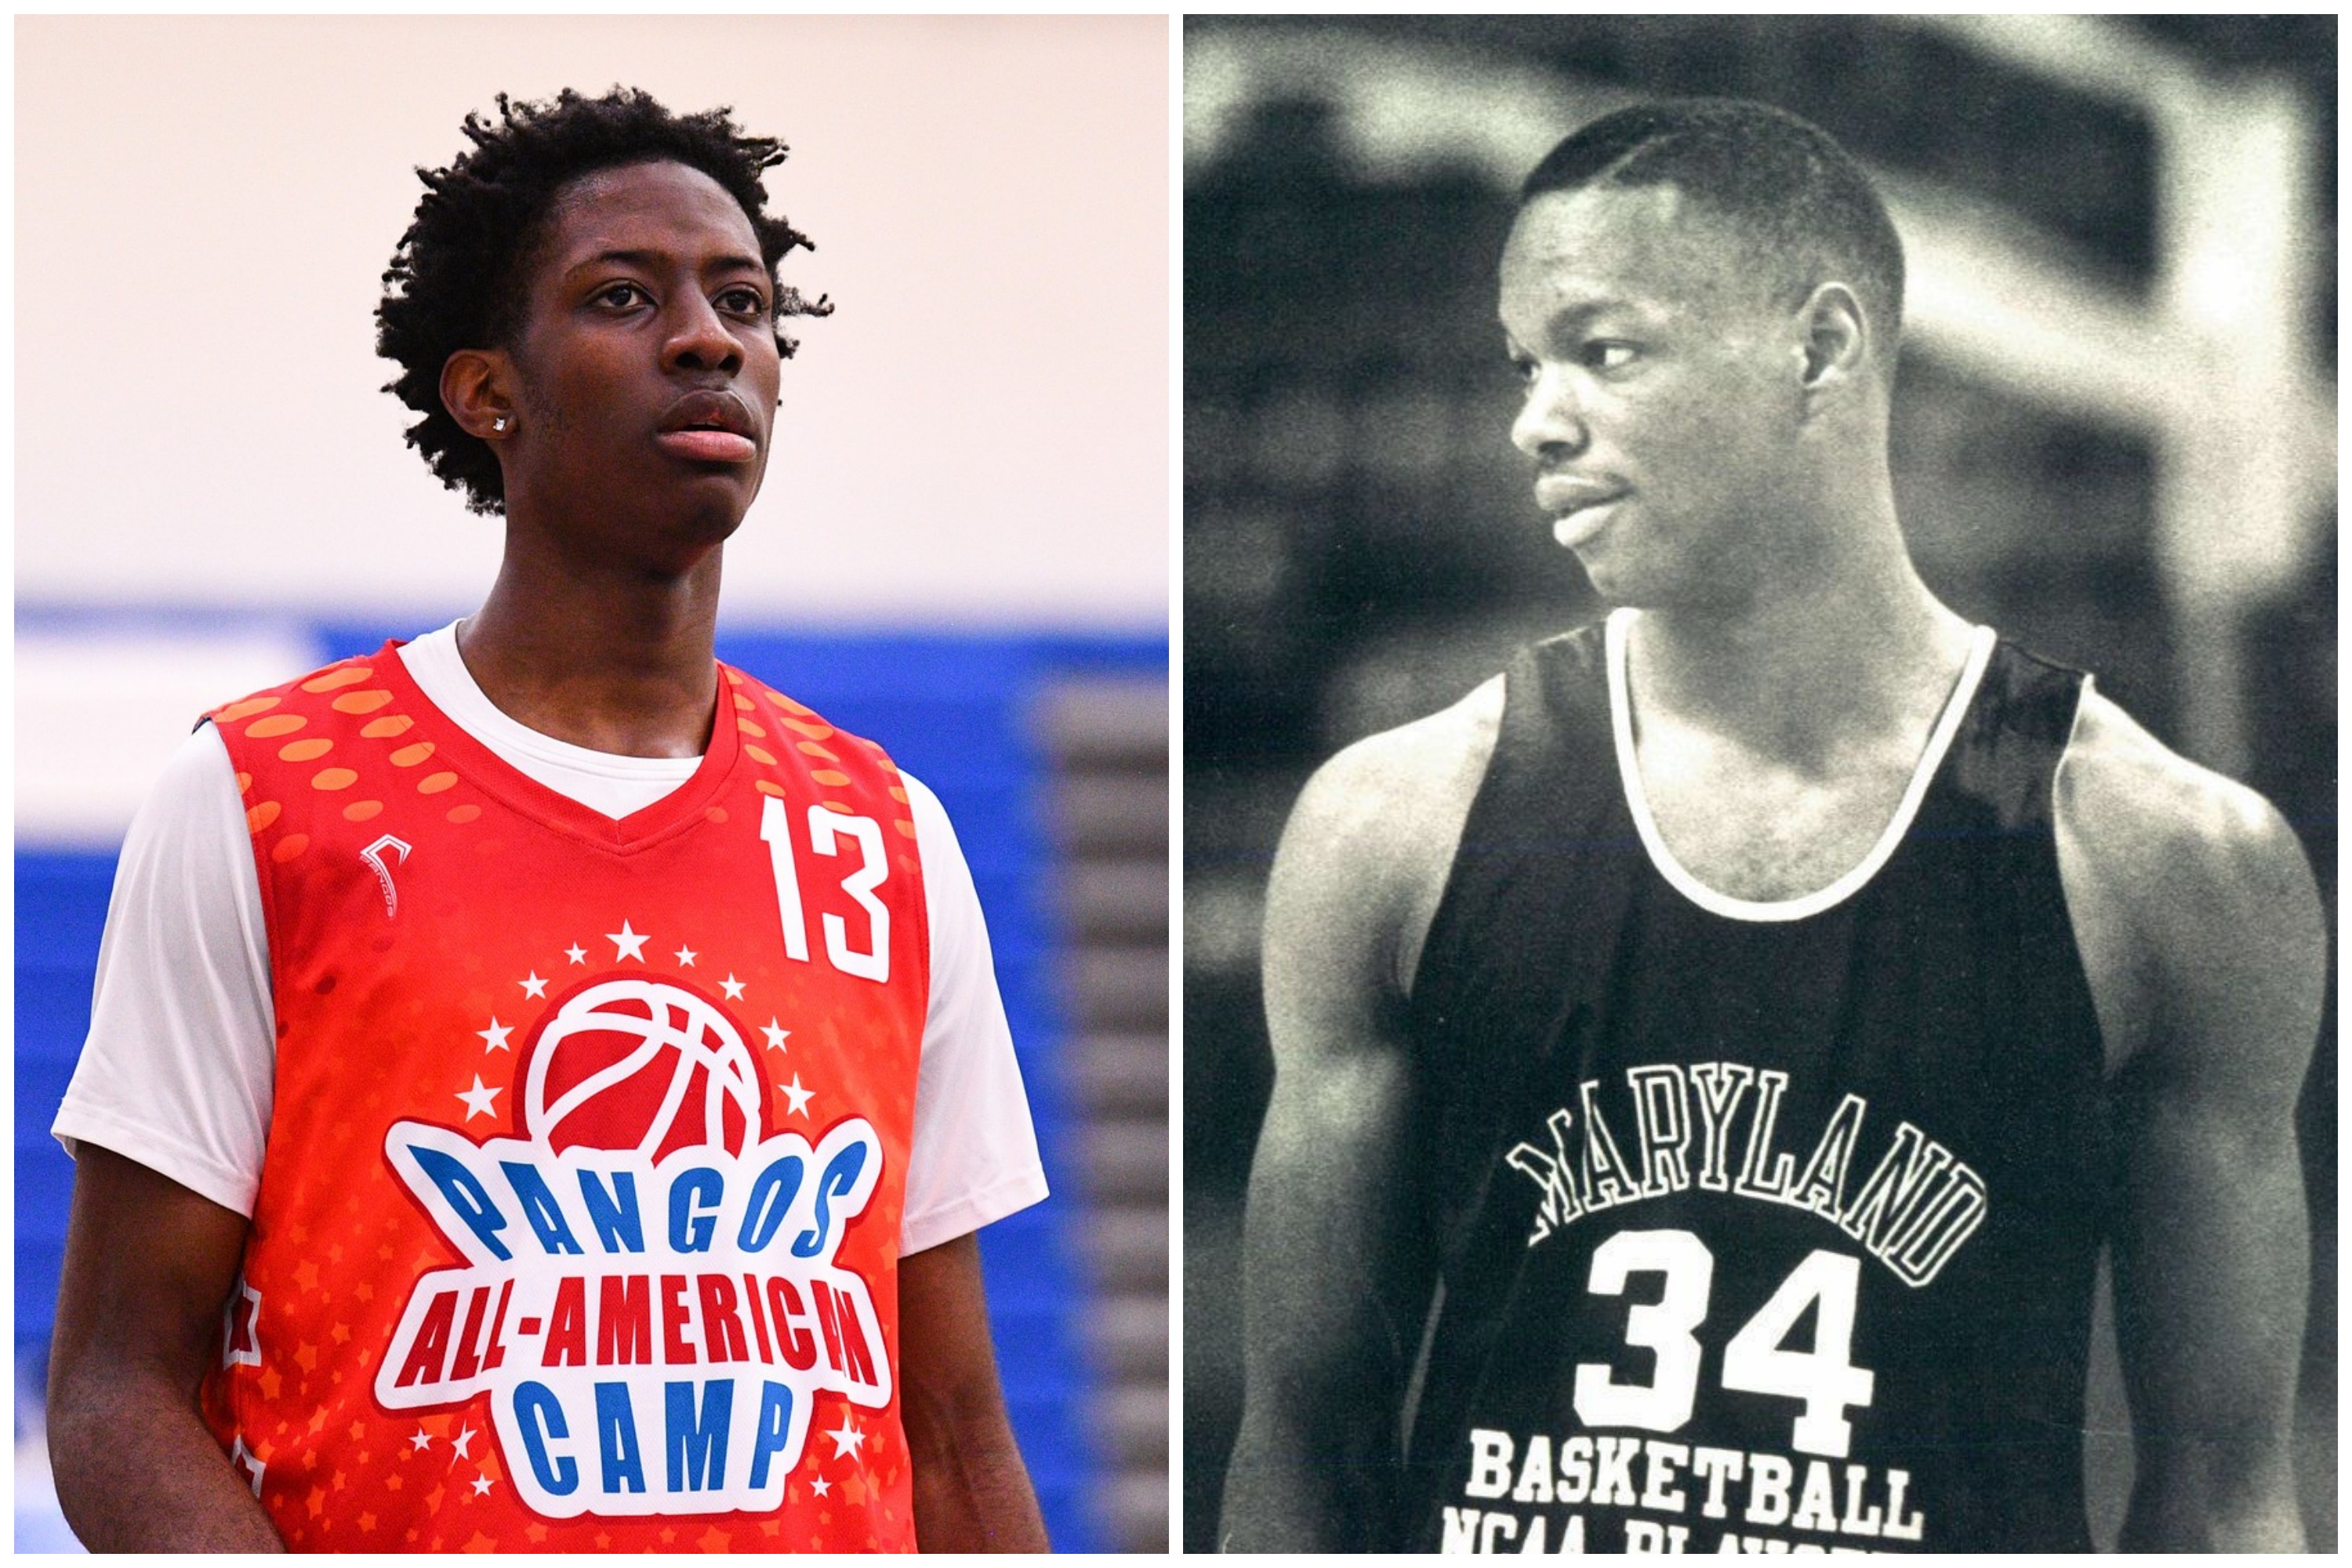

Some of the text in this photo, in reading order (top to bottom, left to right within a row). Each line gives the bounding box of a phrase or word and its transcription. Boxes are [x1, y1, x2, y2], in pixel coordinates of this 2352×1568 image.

[759, 793, 891, 984] 13
[405, 1140, 869, 1261] PANGOS
[1505, 1062, 1987, 1288] MARYLAND
[394, 1272, 880, 1389] ALL-AMERICAN
[1573, 1229, 1875, 1458] 34
[512, 1378, 794, 1497] CAMP
[1465, 1428, 1925, 1541] BASKETBALL
